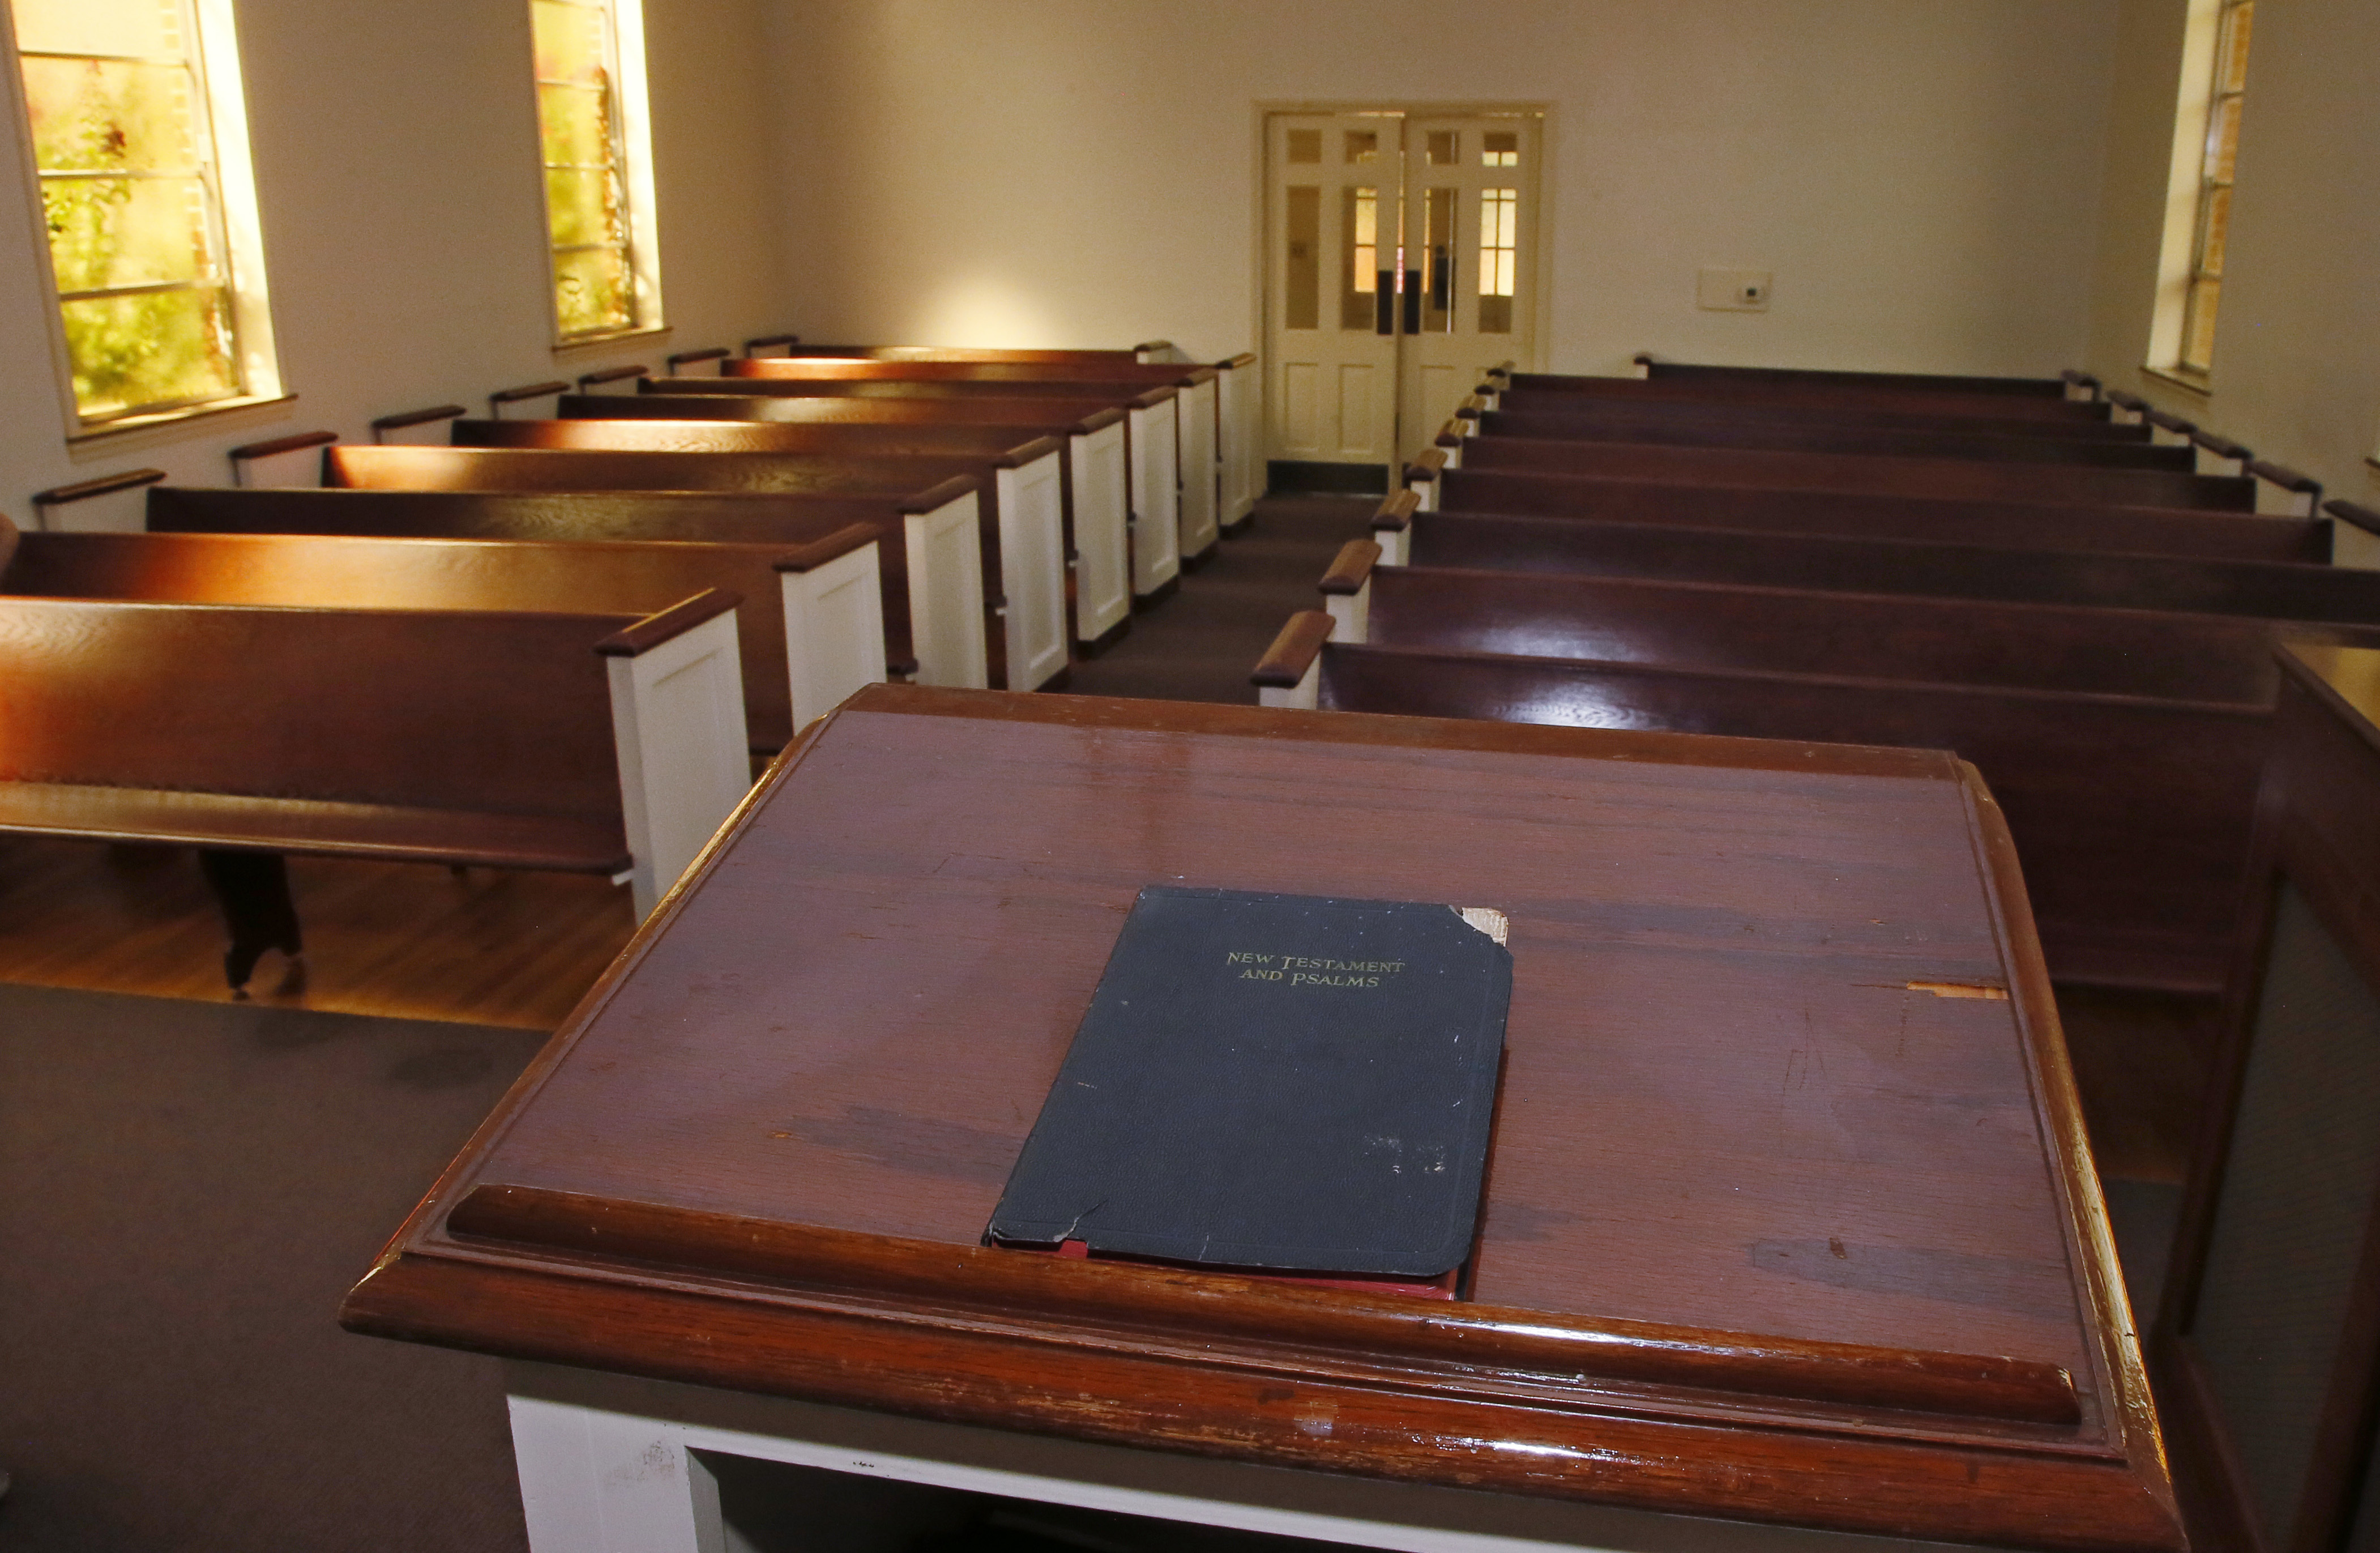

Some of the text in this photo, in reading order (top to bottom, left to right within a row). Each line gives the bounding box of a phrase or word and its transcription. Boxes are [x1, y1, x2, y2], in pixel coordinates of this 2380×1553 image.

[1227, 952, 1405, 972] NEW TESTAMENT
[1239, 969, 1379, 987] AND PSALMS
